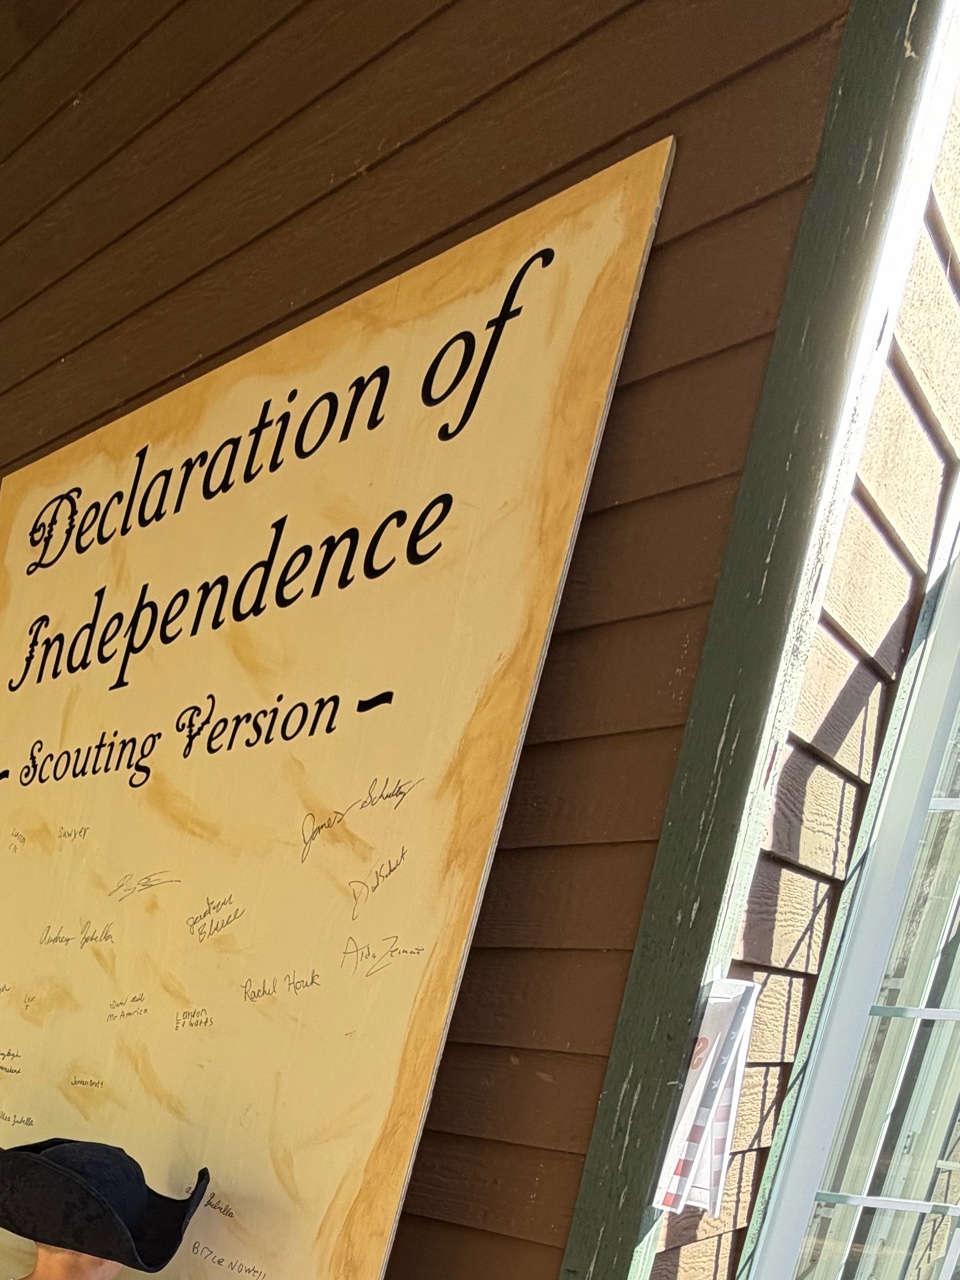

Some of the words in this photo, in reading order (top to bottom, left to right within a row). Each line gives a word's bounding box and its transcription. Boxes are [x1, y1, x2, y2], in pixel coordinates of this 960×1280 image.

[26, 363, 391, 576] Declaration
[421, 248, 554, 441] of
[8, 493, 453, 692] Independence
[19, 730, 161, 788] Scouting
[175, 693, 340, 758] Version
[241, 977, 278, 1002] Rachel
